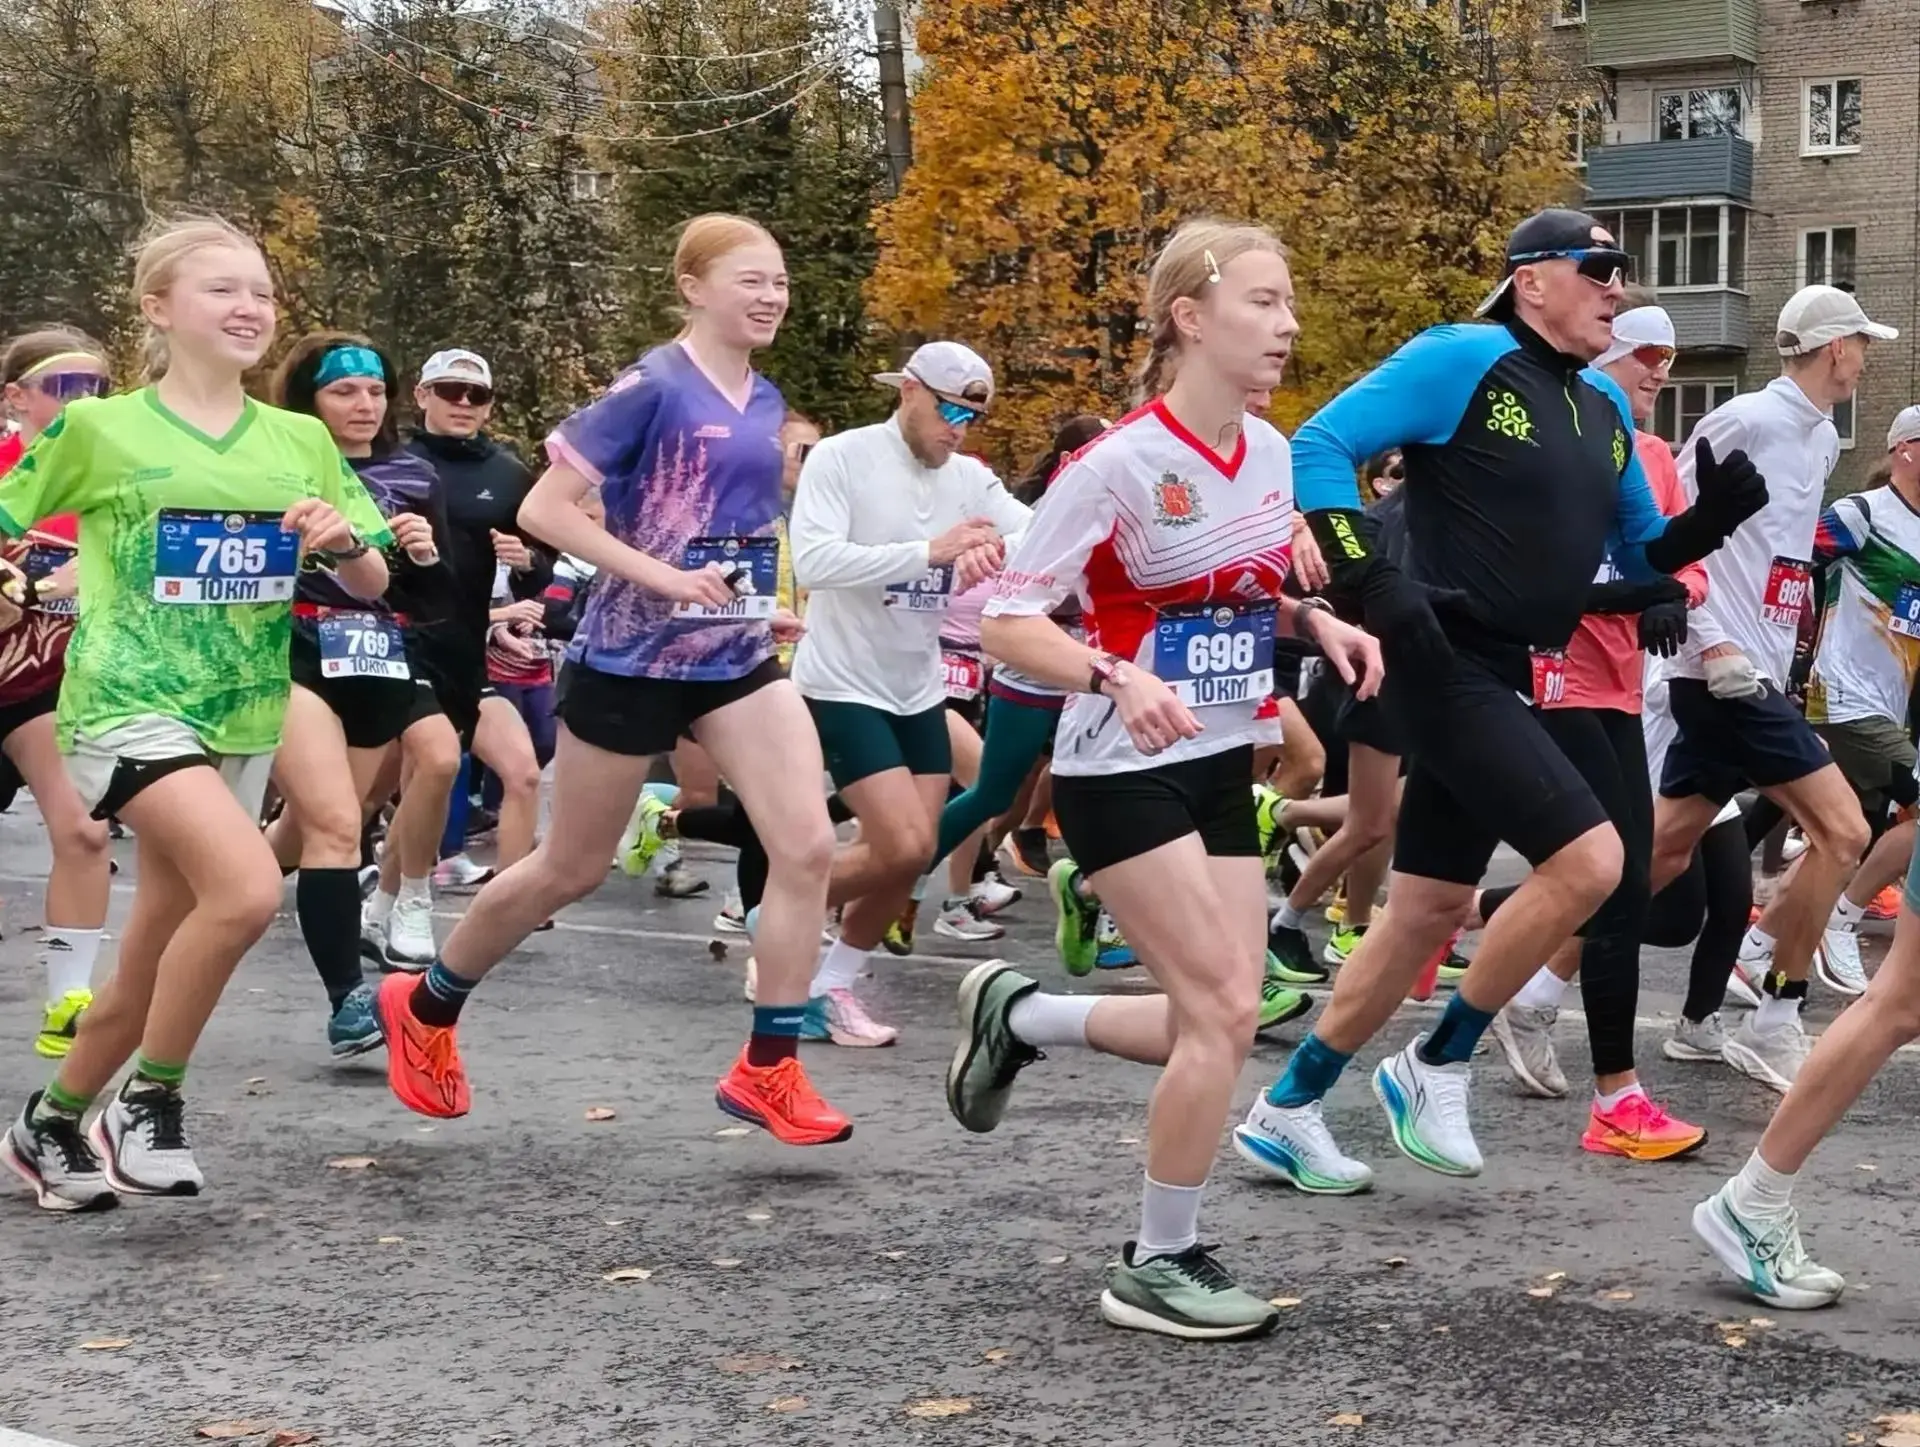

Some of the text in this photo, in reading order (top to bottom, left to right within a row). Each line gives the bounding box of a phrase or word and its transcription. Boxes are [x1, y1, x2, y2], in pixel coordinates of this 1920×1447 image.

[195, 537, 267, 574] 765
[1777, 578, 1806, 607] 882
[1907, 599, 1920, 620] 8
[345, 629, 389, 658] 769
[1187, 631, 1255, 674] 698
[1192, 676, 1249, 704] 10KM
